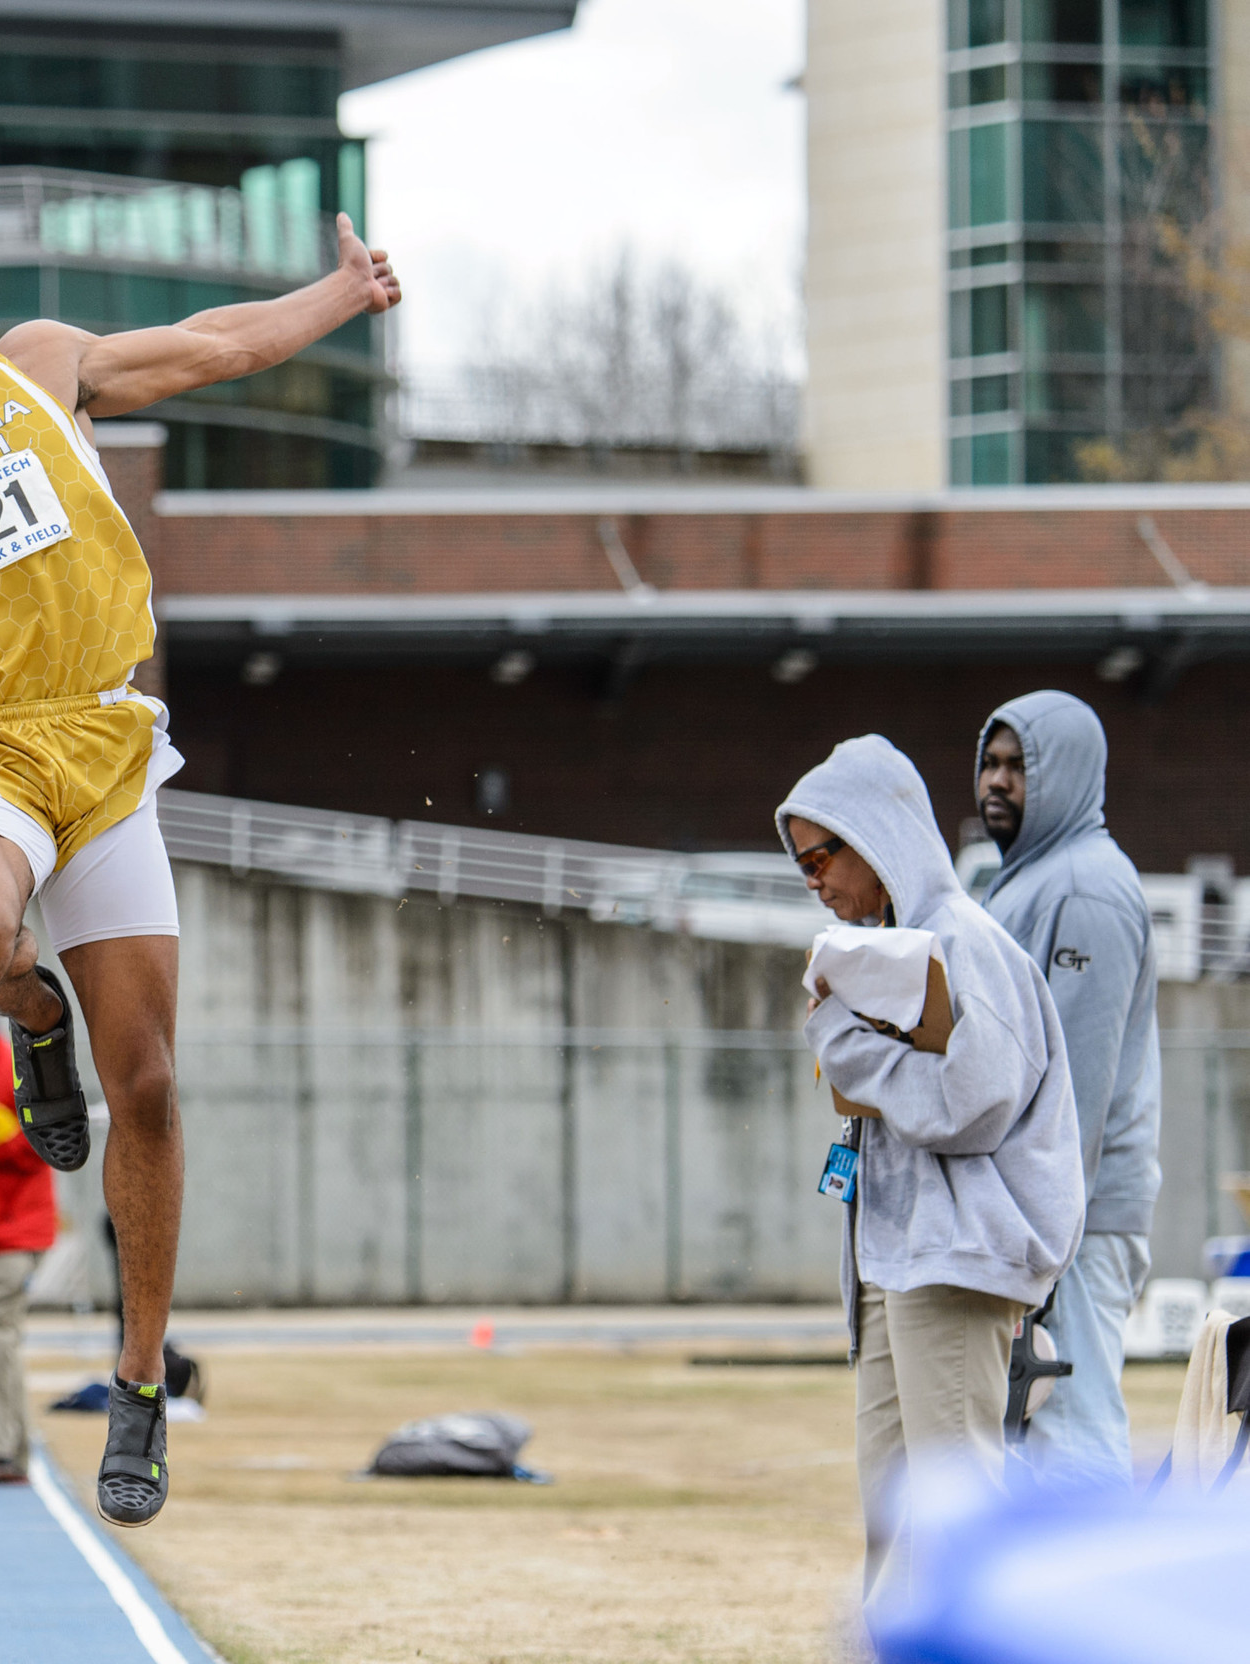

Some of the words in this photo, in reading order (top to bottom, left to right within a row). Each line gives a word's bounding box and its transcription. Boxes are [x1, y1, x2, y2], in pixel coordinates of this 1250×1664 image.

[11, 541, 22, 553] &
[25, 524, 61, 546] FIELD
[1054, 947, 1091, 973] GT
[138, 1384, 158, 1396] NIKE
